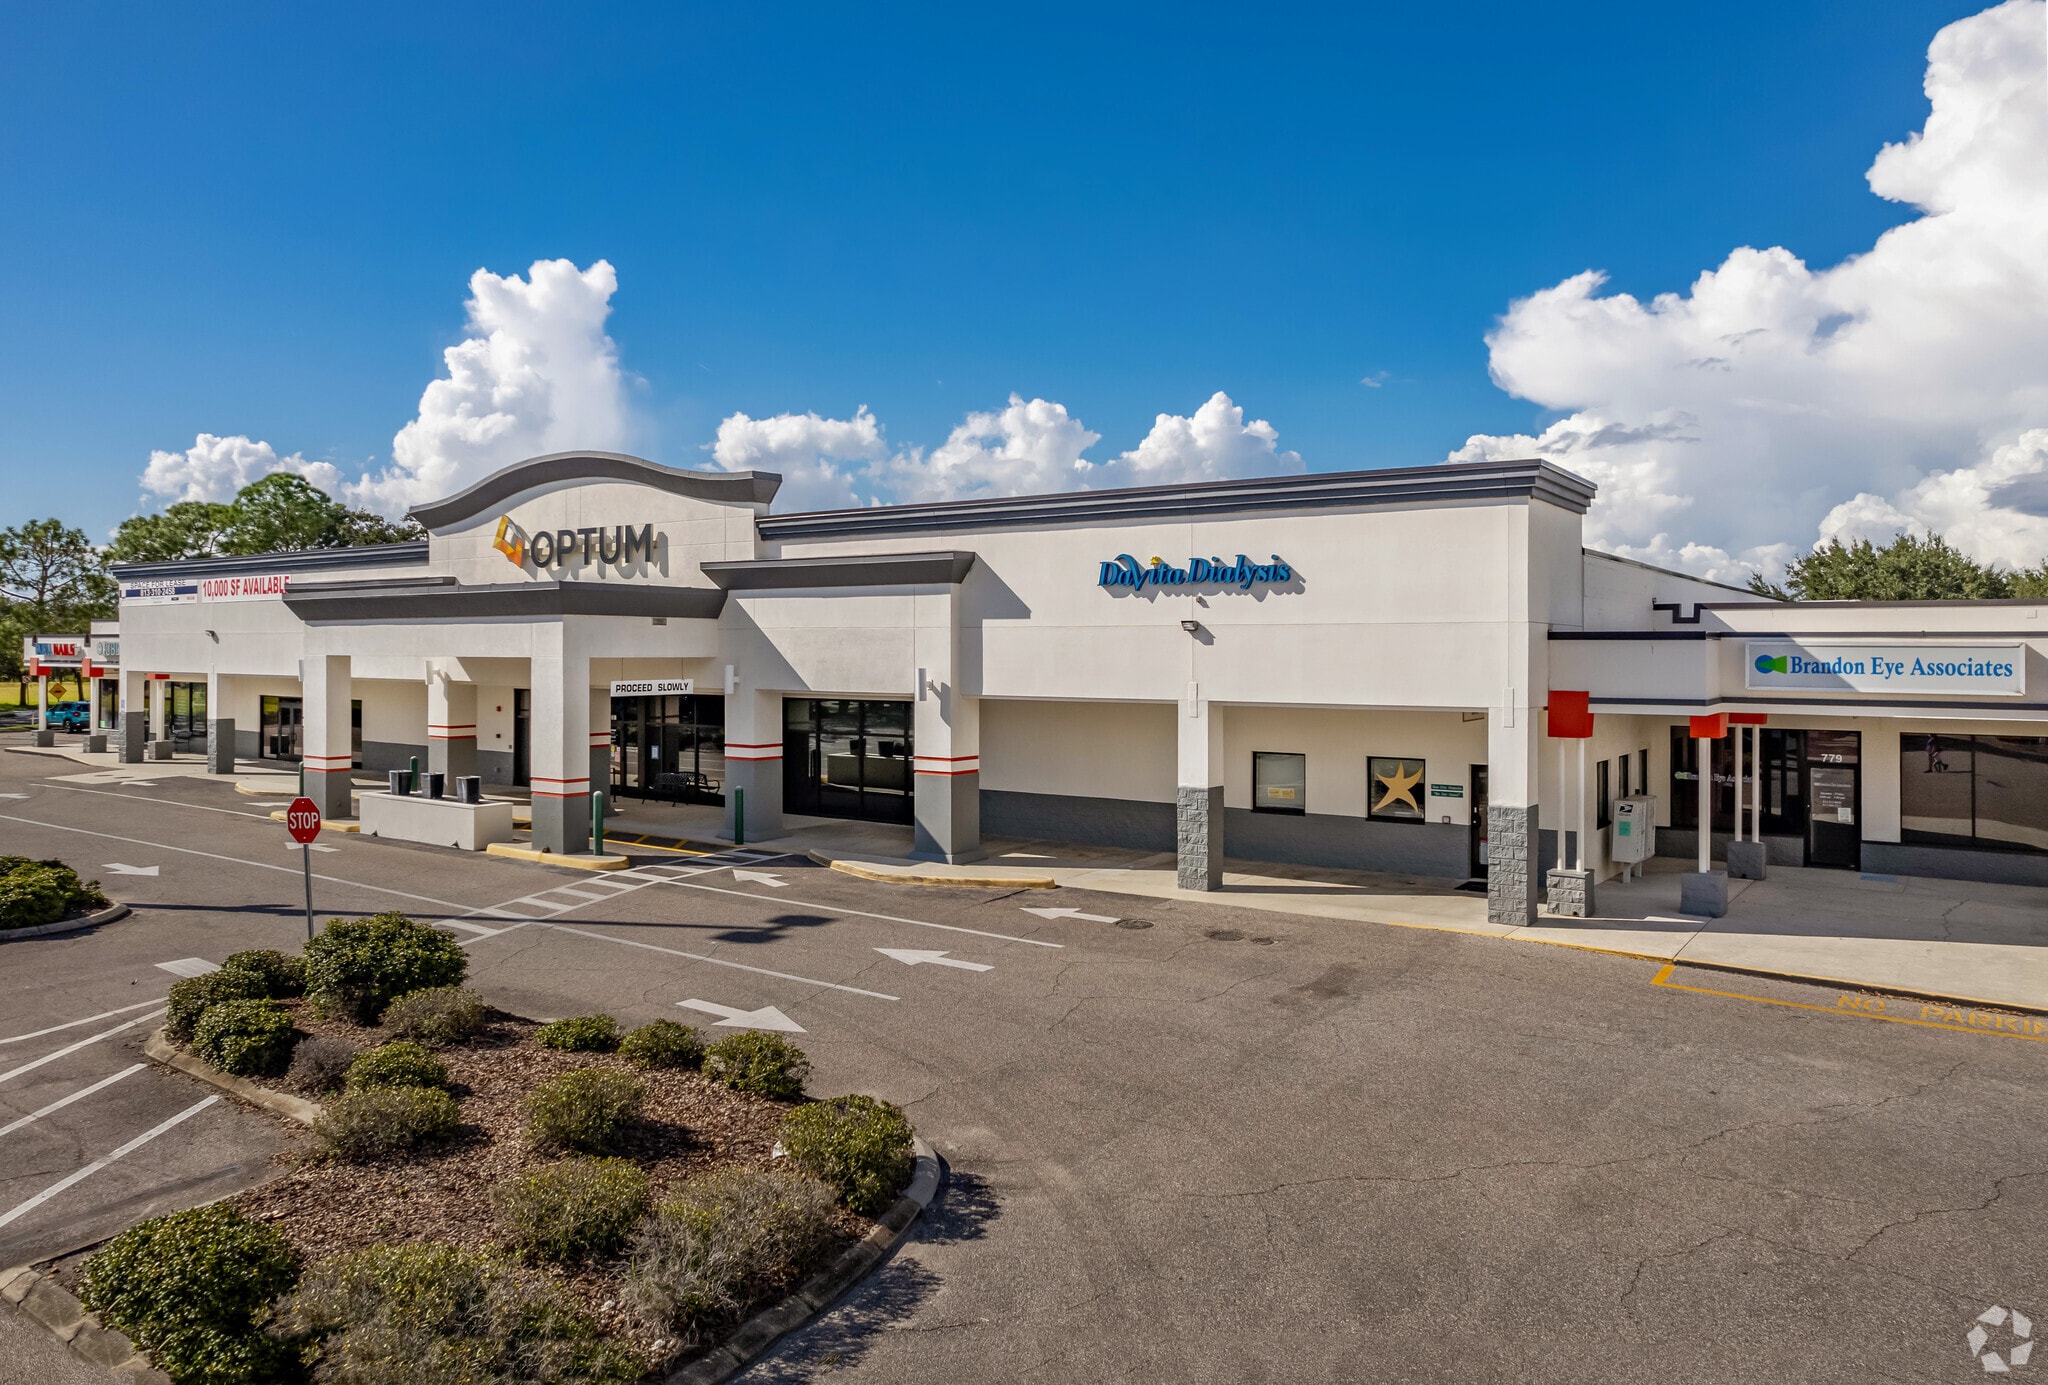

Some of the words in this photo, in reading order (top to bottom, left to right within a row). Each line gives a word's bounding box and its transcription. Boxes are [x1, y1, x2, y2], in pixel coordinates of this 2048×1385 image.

[530, 523, 656, 569] OPTUM
[1097, 553, 1186, 592] DaVita
[1187, 553, 1291, 590] Dialysis
[130, 580, 151, 590] SPACE
[151, 579, 164, 588] FOR
[165, 578, 187, 587] LEASE
[203, 579, 229, 600] 10,000
[230, 578, 241, 597] SF
[53, 643, 76, 656] NAILS
[1790, 656, 1866, 676] Brandon
[1870, 656, 1905, 680] Eye
[1910, 657, 2014, 678] Associates
[615, 683, 653, 693] PROCEED
[657, 682, 689, 692] SLOWLY
[1821, 753, 1843, 763] 779
[289, 812, 319, 830] STOP
[1837, 994, 1887, 1013] NO
